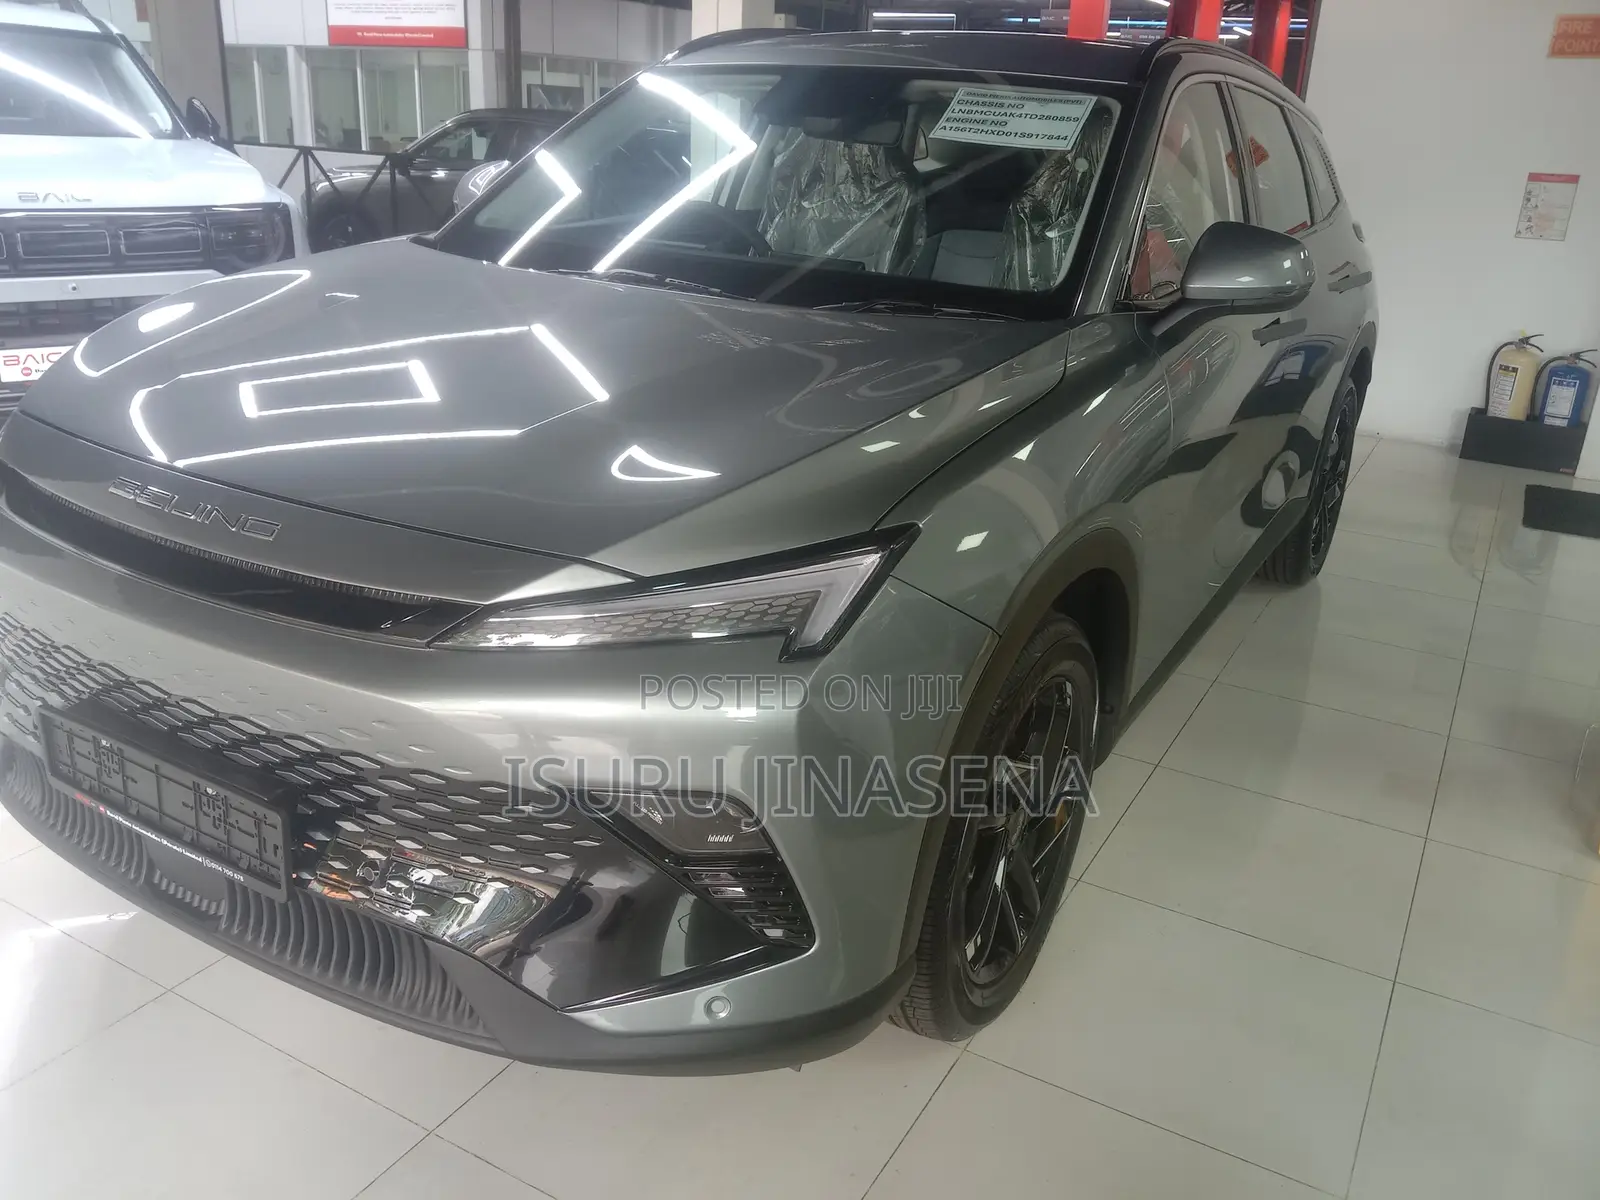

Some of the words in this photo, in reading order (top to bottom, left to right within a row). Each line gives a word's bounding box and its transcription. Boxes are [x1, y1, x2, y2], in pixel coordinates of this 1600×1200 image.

[1559, 20, 1594, 34] FIRE
[957, 100, 1006, 108] CHASSIS
[945, 117, 989, 125] ENGINE
[2, 351, 62, 366] BAIC
[108, 476, 282, 541] BEIJING
